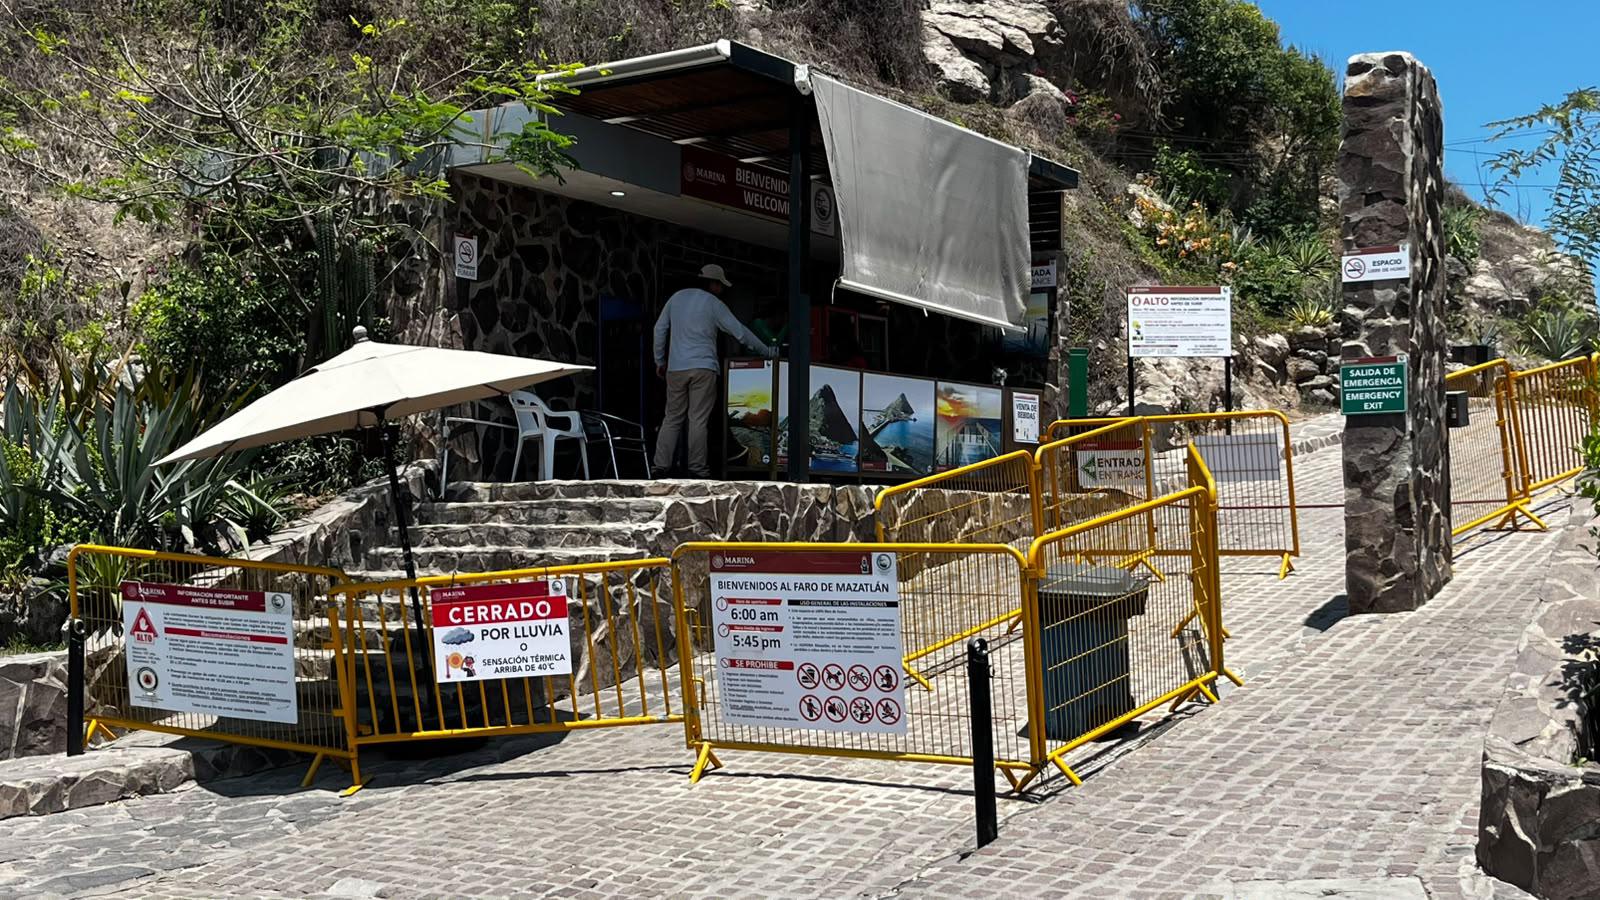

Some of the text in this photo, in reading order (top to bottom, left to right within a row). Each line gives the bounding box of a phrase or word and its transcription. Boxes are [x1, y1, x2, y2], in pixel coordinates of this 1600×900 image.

[696, 168, 726, 184] MARINA
[735, 168, 790, 194] BIENVENID
[1372, 259, 1402, 267] ESPACIO
[1143, 297, 1169, 306] ALTO
[1349, 367, 1396, 377] SALIDA DE
[1344, 377, 1402, 387] EMERGENCIA
[1345, 391, 1401, 400] EMERGENCY
[1363, 402, 1383, 410] EXIT
[724, 557, 755, 565] MARINA
[718, 581, 889, 593] BIENVENIDOS AL FARO DE MAZATLÁN
[448, 600, 552, 624] CERRADO
[731, 608, 757, 620] 6:00
[760, 611, 779, 621] am
[481, 624, 563, 640] POR LLUVIA
[137, 633, 153, 642] ALTO
[733, 634, 759, 647] 5:45
[762, 639, 781, 650] pm
[520, 642, 528, 651] O
[482, 653, 565, 666] SENSACIÓN TÉRMICA
[735, 660, 744, 668] SE
[494, 665, 522, 674] ARRIBA
[525, 664, 536, 672] DE
